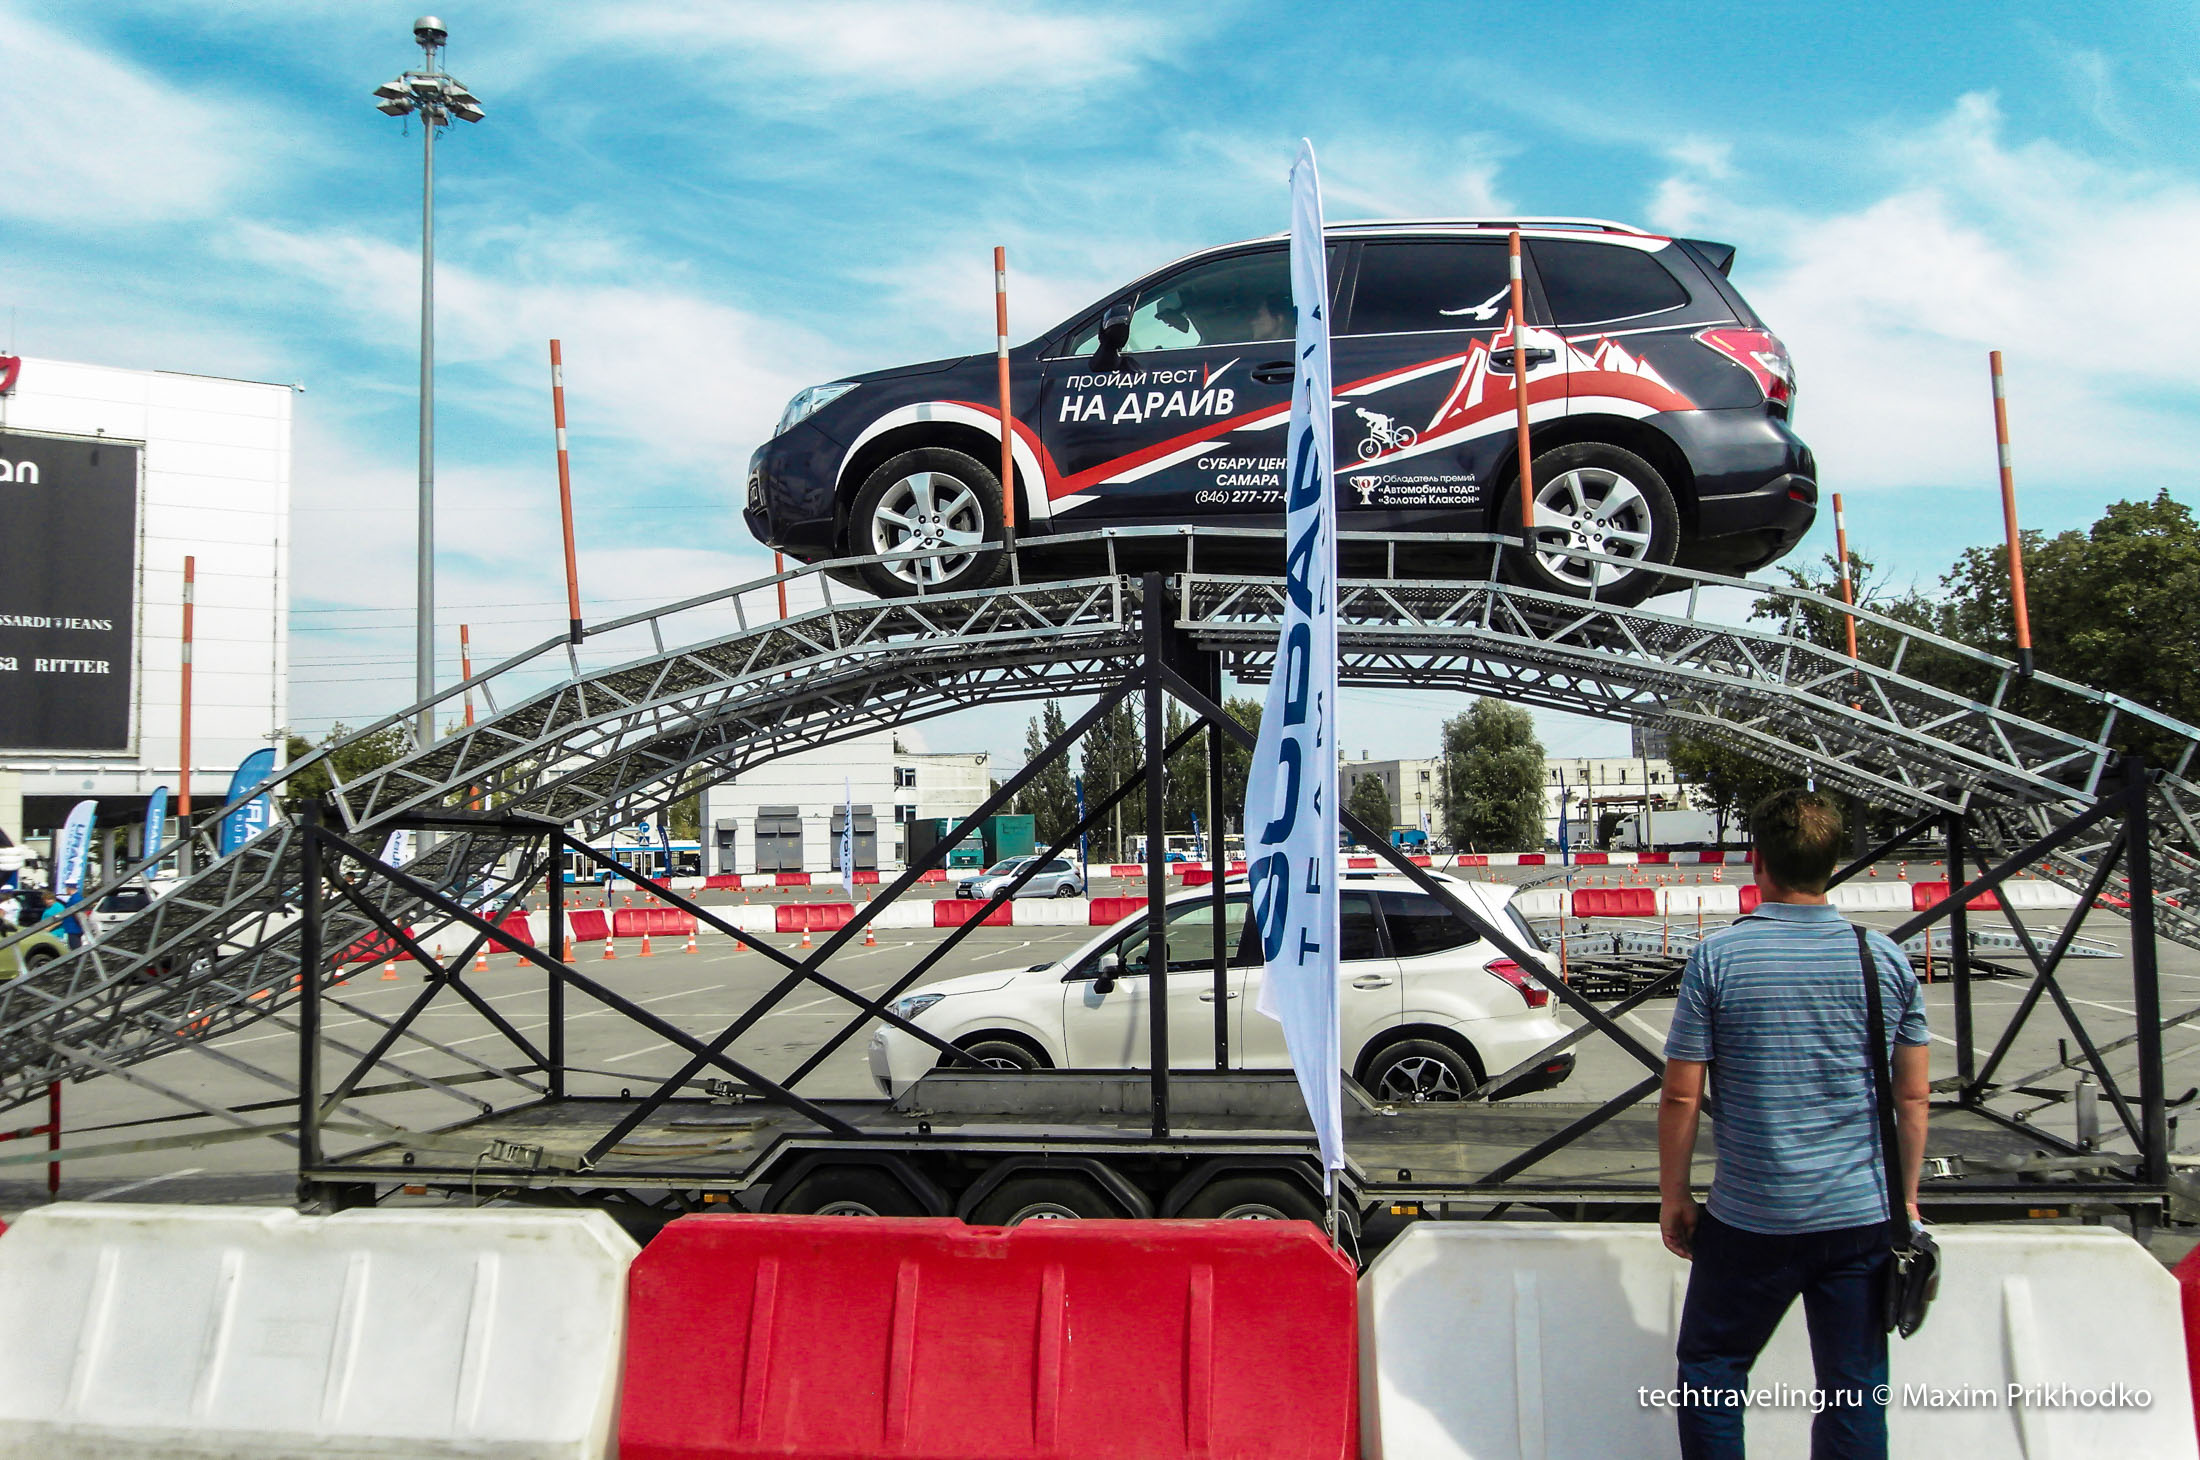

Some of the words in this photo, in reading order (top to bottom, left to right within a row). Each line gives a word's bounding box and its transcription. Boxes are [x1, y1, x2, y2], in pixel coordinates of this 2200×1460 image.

[1066, 371, 1147, 391] пройди
[1151, 369, 1197, 385] тест
[1058, 395, 1107, 423] НА
[1197, 457, 1256, 470] СУБАРУ
[1257, 457, 1287, 471] ЦЕН
[1215, 474, 1280, 486] САМАРА
[1383, 474, 1439, 483] Обладатель
[1440, 473, 1476, 483] премий
[1195, 490, 1230, 504] (846)
[64, 618, 112, 630] JEANS
[1249, 305, 1322, 962] SUBAR
[35, 658, 110, 674] RITTER
